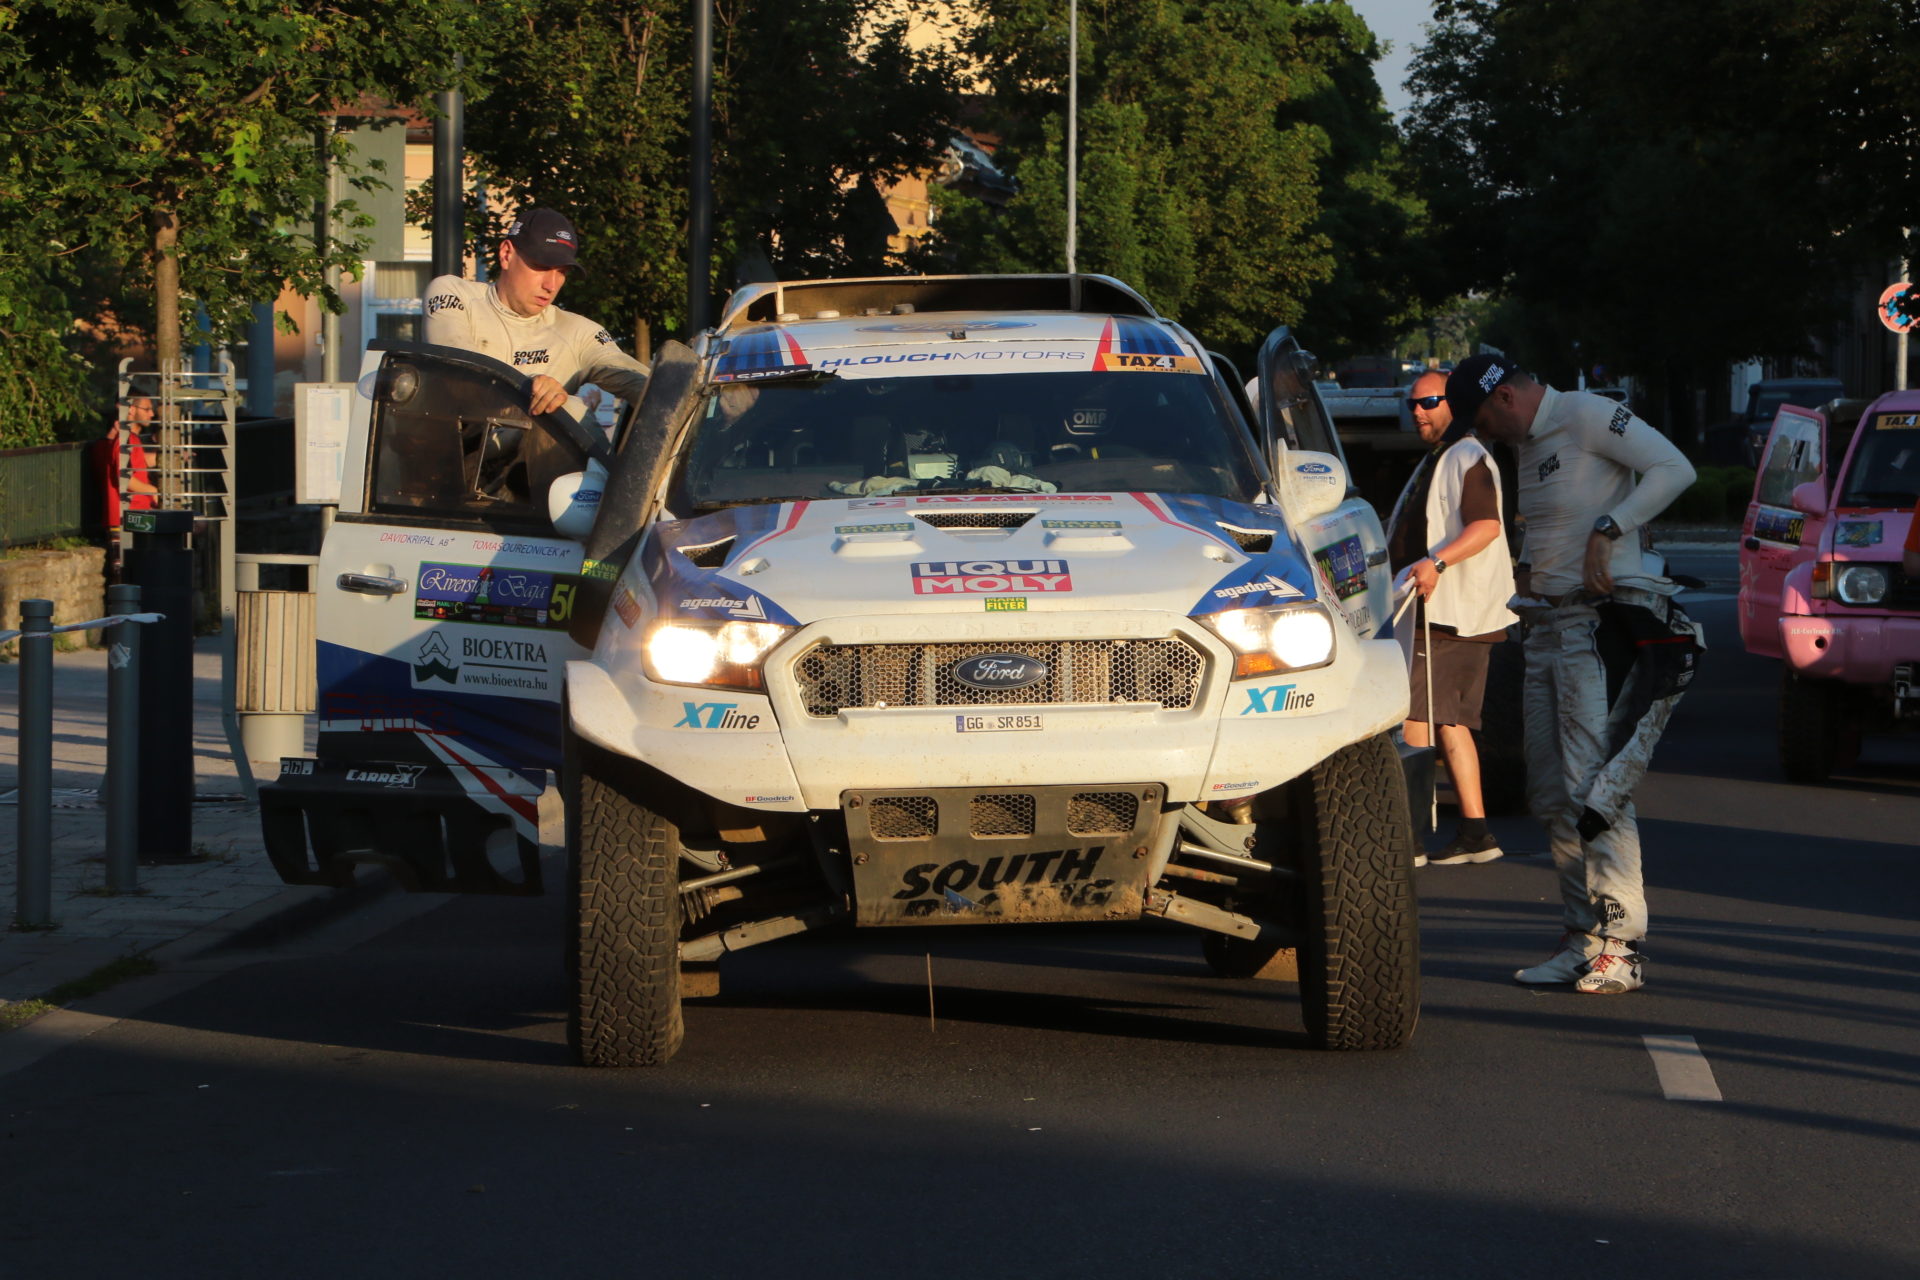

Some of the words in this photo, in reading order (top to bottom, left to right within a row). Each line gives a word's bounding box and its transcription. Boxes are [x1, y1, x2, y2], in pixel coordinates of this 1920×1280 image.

[428, 294, 460, 306] SOUTH
[513, 349, 547, 358] SOUTH
[1478, 363, 1499, 388] SOUTH
[1073, 412, 1107, 424] OMP
[1303, 463, 1325, 473] Ford
[127, 514, 142, 526] EXIT
[581, 567, 617, 581] FILTER
[583, 560, 619, 573] MANN
[918, 560, 1062, 577] LIQUI
[498, 574, 549, 605] Baja
[920, 575, 1068, 594] MOLY
[1214, 581, 1276, 599] agados
[680, 597, 745, 610] agados
[986, 601, 1026, 610] FILTER
[857, 621, 1145, 637] RANGER
[463, 637, 548, 663] BIOEXTRA
[973, 659, 1025, 681] Ford
[464, 673, 548, 691] www.bioextra.hu
[1240, 684, 1315, 715] XTline
[673, 702, 760, 729] XTline
[966, 717, 984, 729] GG
[997, 716, 1014, 729] SR
[1016, 715, 1041, 728] 851
[1212, 780, 1260, 790] BFGoodrich
[893, 846, 1105, 900] SOUTH
